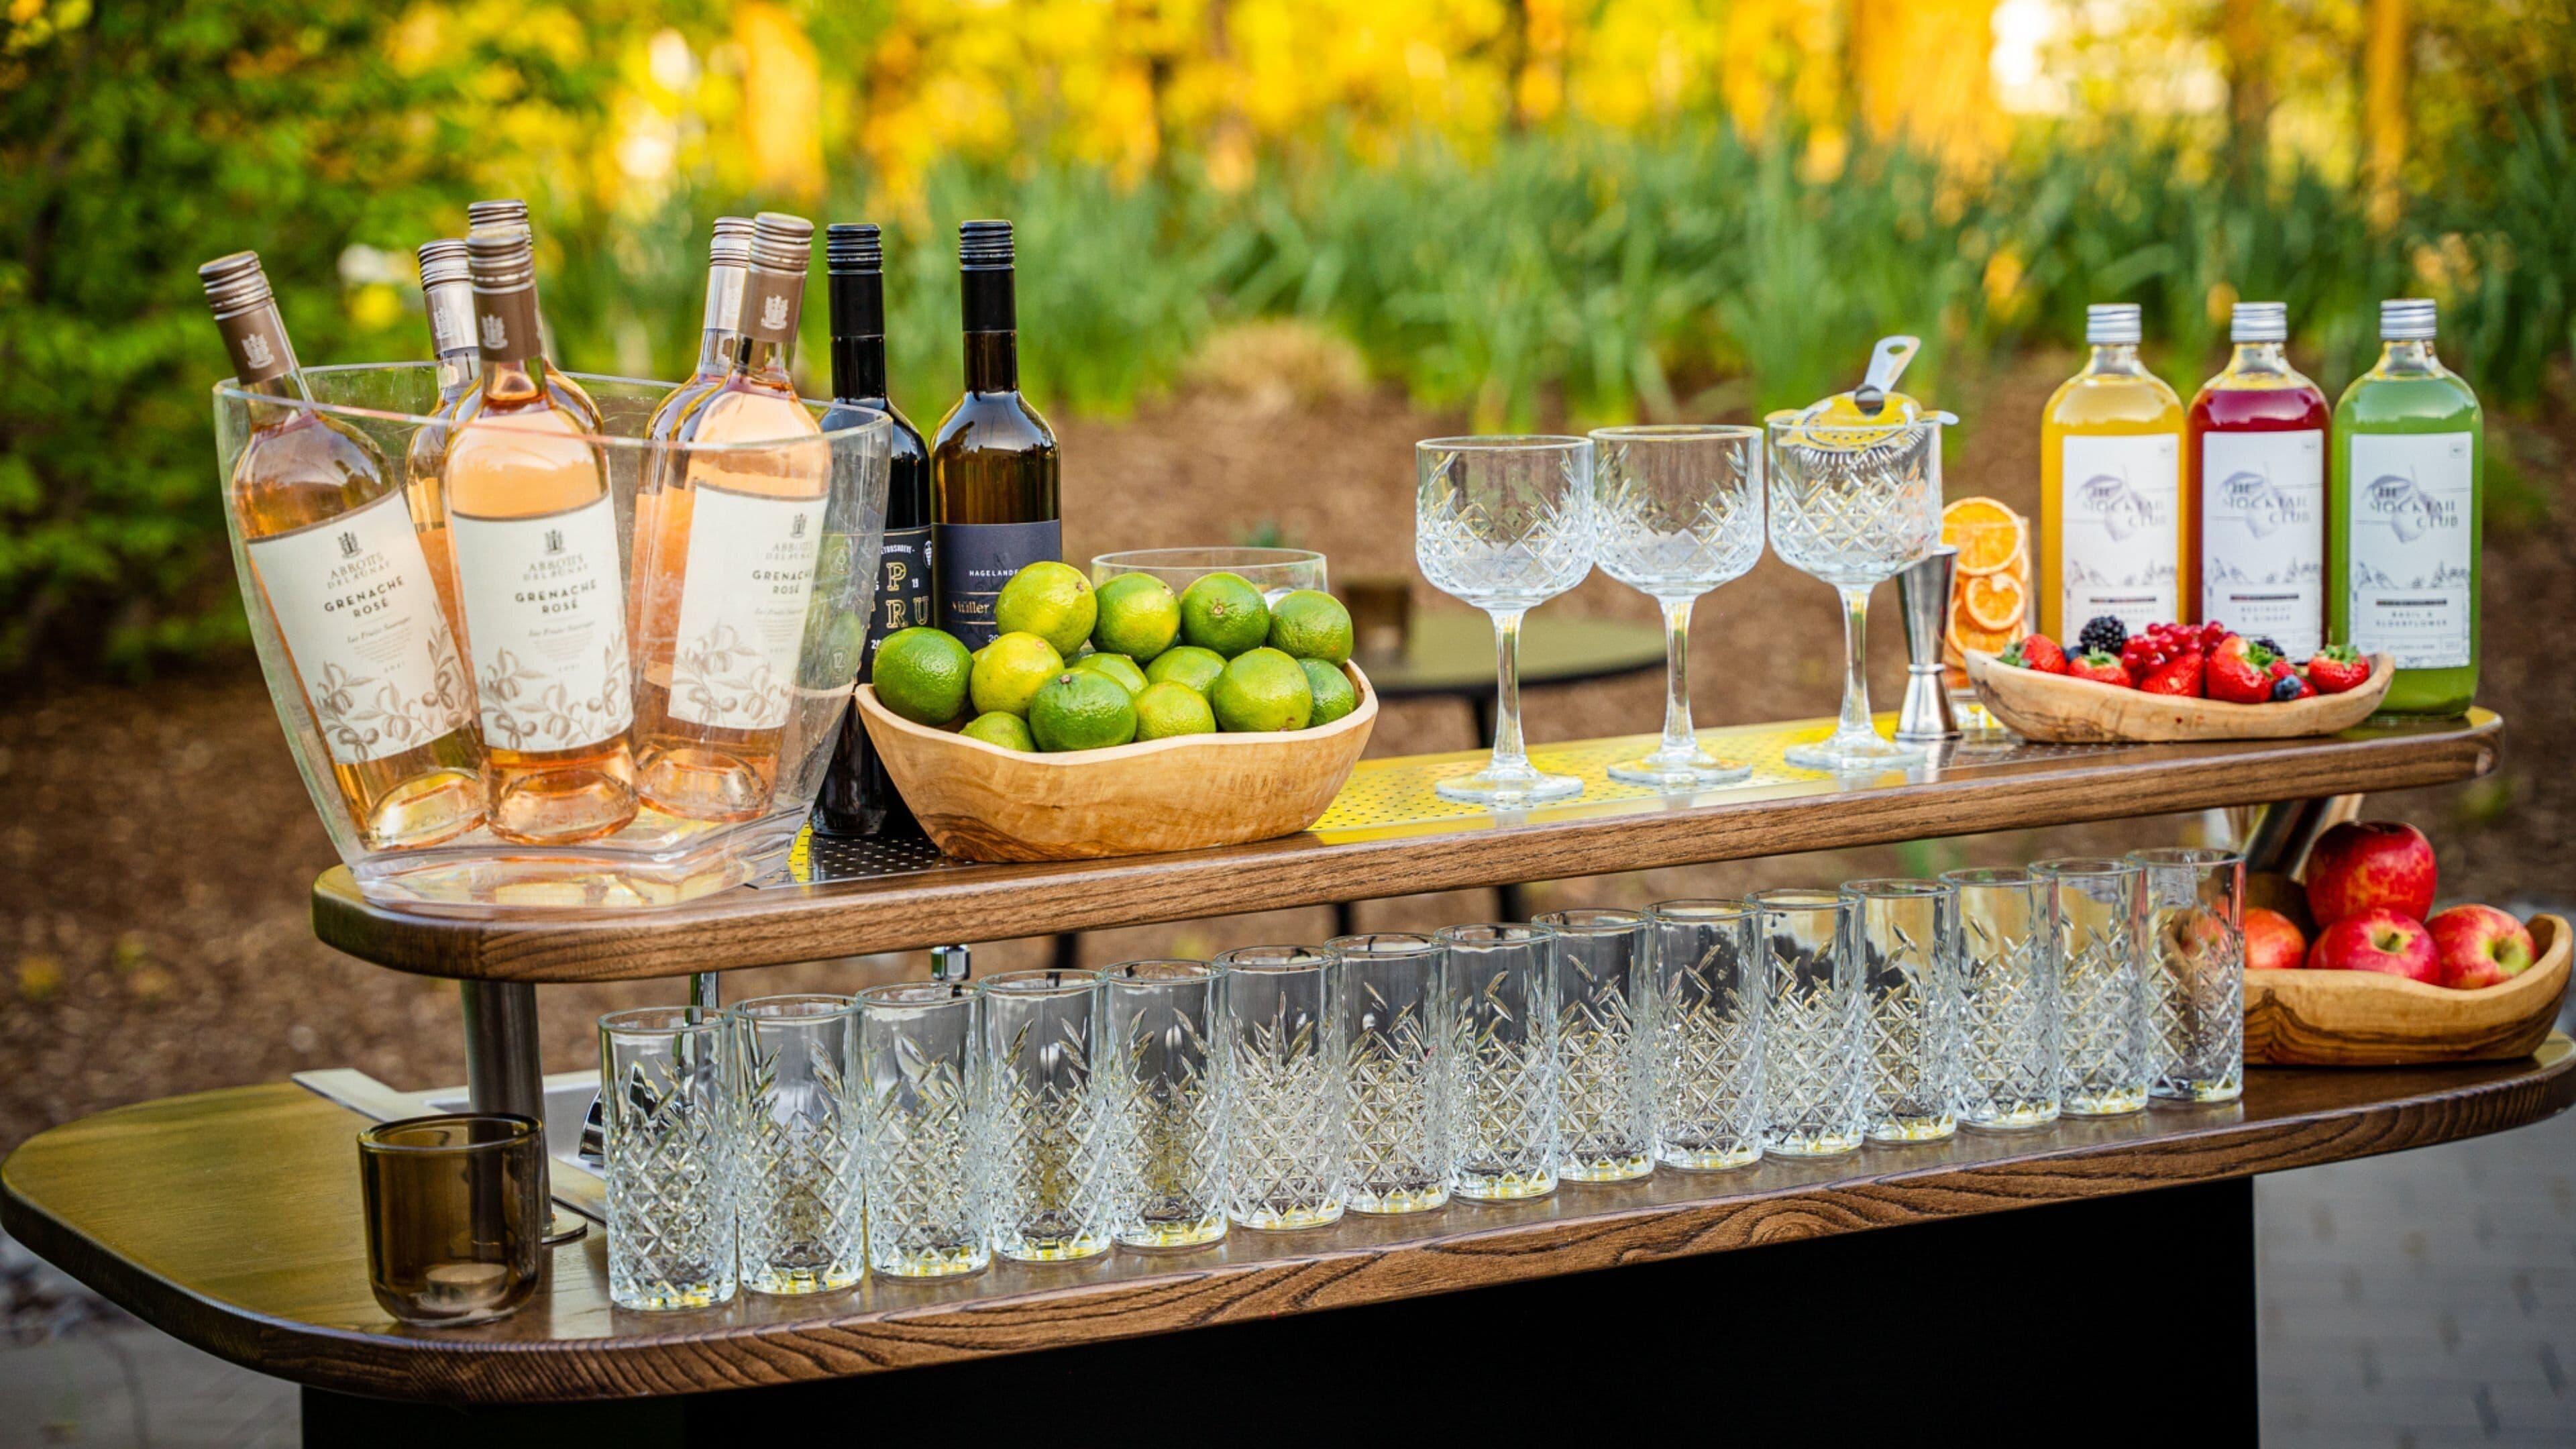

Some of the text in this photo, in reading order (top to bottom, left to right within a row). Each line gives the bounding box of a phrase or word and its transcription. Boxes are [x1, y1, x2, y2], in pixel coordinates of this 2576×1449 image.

[2222, 496, 2308, 510] MOCKTAIL
[2369, 500, 2455, 513] MOCKTAIL
[2269, 510, 2312, 523] CLUB
[2416, 515, 2459, 528] CLUB
[886, 561, 908, 592] P
[969, 569, 1020, 577] HAGELANDE
[324, 576, 405, 612] GRENACHE
[515, 579, 597, 602] GRENACHE
[773, 582, 800, 594] ROSÉ
[353, 597, 389, 617] ROSÉ
[542, 598, 578, 614] ROSÉ
[952, 601, 990, 614] Müller
[871, 639, 881, 650] 20
[988, 634, 1000, 643] 20
